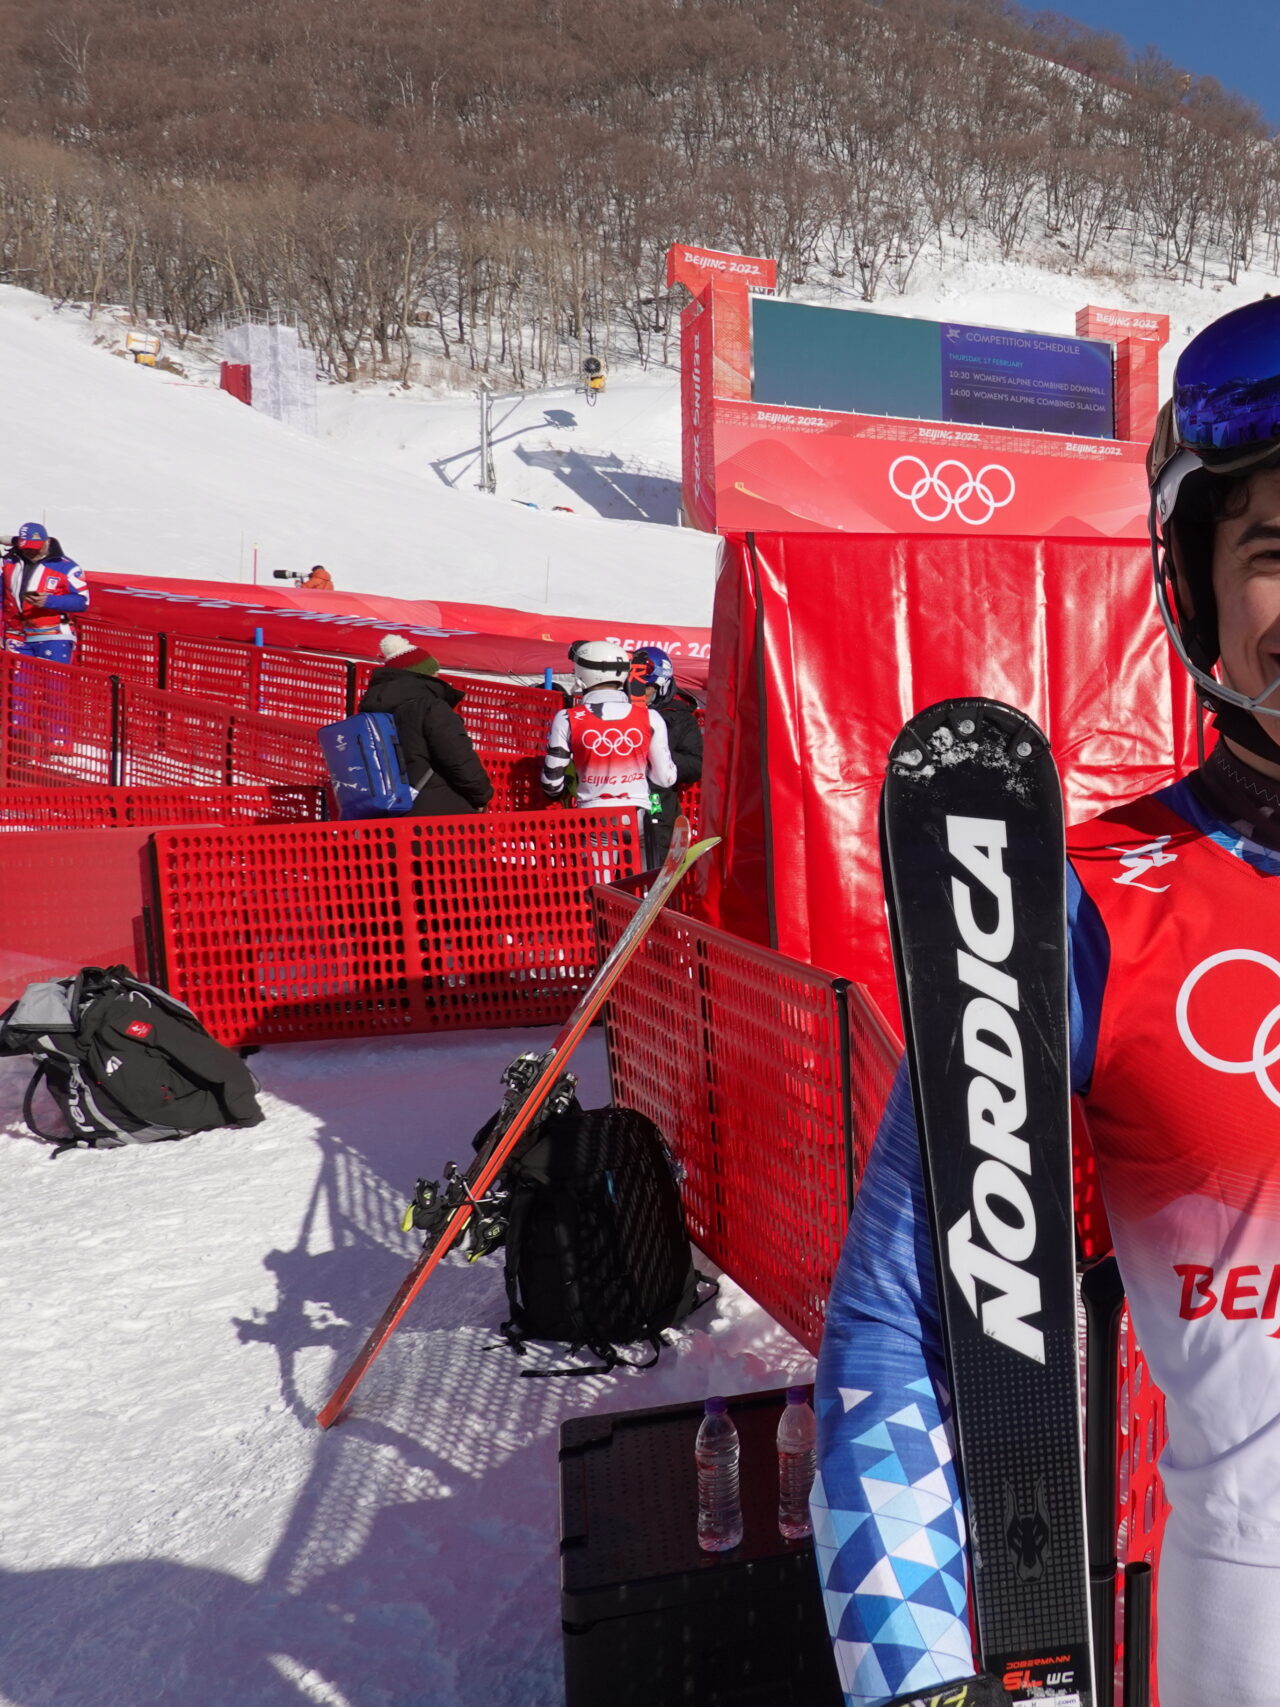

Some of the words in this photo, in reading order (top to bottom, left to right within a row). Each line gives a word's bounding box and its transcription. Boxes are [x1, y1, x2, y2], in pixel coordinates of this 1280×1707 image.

[684, 252, 727, 270] BEIJING
[729, 262, 761, 275] 2022
[1096, 313, 1130, 328] BEIJING
[1133, 318, 1159, 329] 2022
[966, 332, 1031, 348] COMPETITION
[1034, 341, 1080, 355] SCHEDULE
[992, 358, 1024, 368] FEBRUARY
[691, 332, 701, 426] BEIJING
[949, 370, 970, 379] 10:30
[973, 372, 1006, 384] WOMEN'S
[1007, 377, 1031, 387] ALPINE
[1032, 379, 1069, 391] COMBINED
[1070, 384, 1105, 395] DOWNHILL
[949, 388, 970, 397] 14:00
[974, 391, 1009, 402] WOMEN'S
[1010, 395, 1035, 405] ALPINE
[1036, 398, 1075, 408] COMBINED
[1076, 402, 1106, 412] SLALOM
[757, 411, 798, 425] BEIJING
[798, 415, 826, 427] 2022
[918, 427, 953, 440] BEIJING
[953, 430, 980, 442] 2022
[1065, 441, 1098, 455] BEIJING
[1099, 446, 1122, 457] 2022
[692, 435, 701, 505] 2022
[581, 774, 617, 786] BEIJING
[621, 772, 645, 783] 2022
[946, 815, 1046, 1366] NORDICA
[1005, 1654, 1071, 1670] DOBERMANN
[1002, 1669, 1043, 1691] SL
[1046, 1671, 1074, 1685] WC
